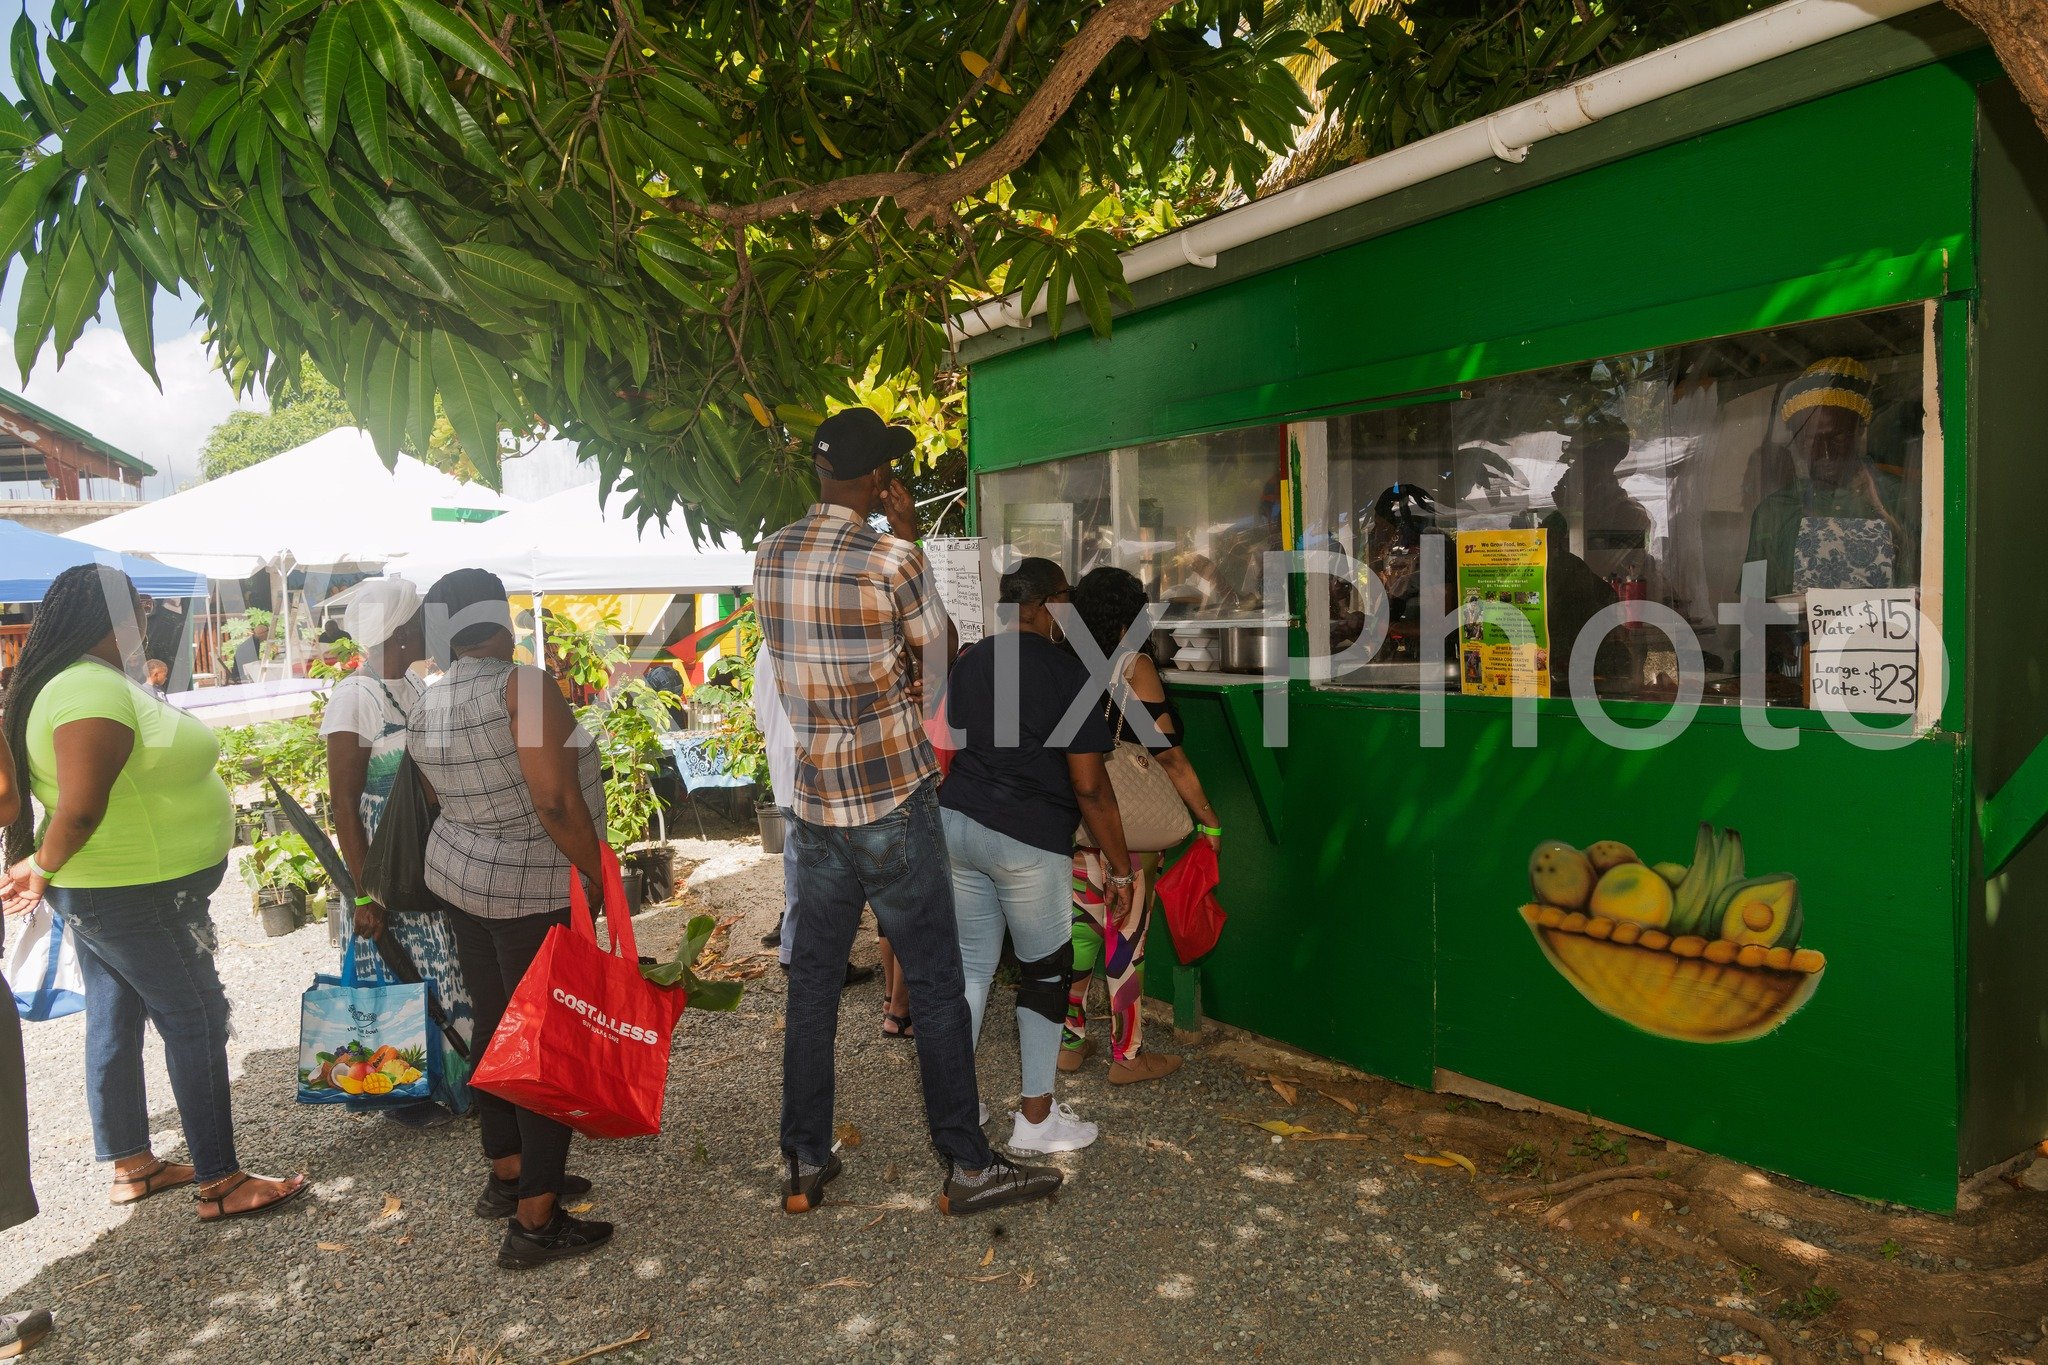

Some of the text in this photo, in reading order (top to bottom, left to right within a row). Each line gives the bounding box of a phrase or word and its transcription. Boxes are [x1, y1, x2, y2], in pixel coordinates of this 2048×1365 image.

[927, 541, 940, 551] Menu
[1812, 598, 1911, 640] Small $15
[1815, 662, 1917, 704] Large $23
